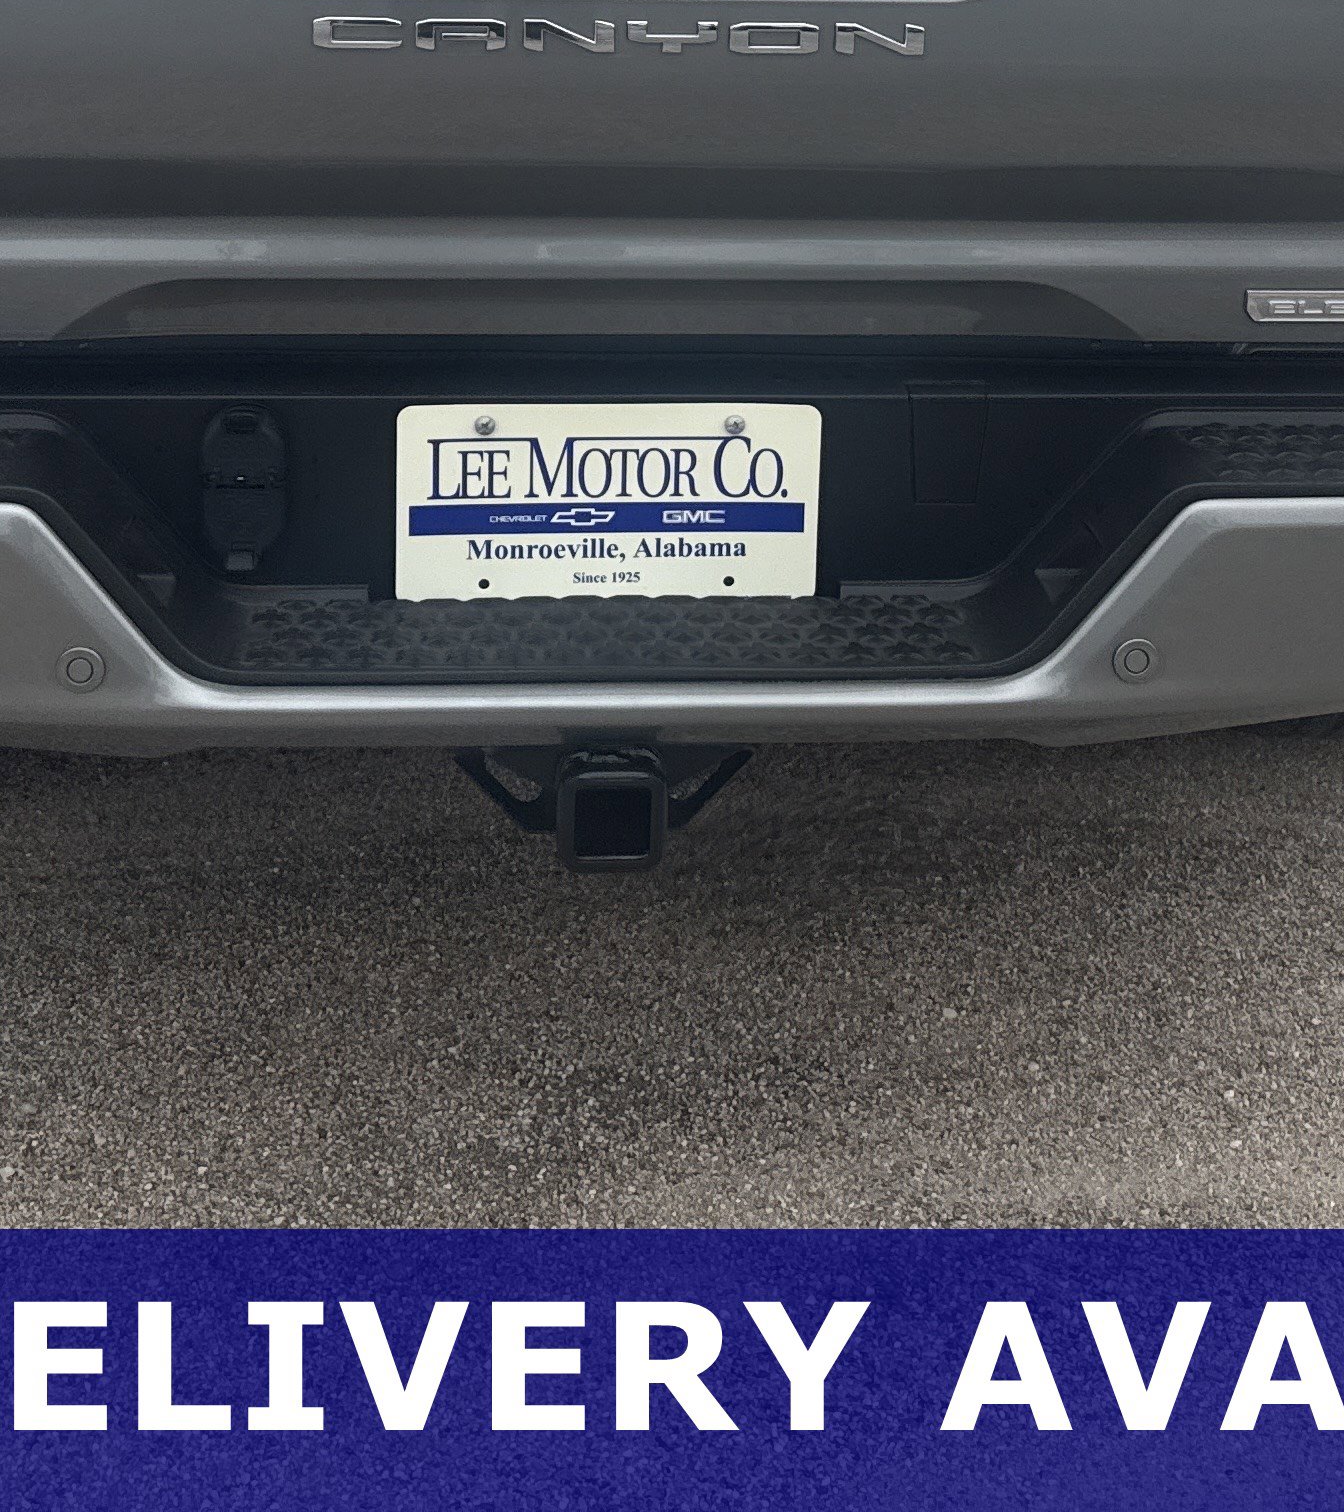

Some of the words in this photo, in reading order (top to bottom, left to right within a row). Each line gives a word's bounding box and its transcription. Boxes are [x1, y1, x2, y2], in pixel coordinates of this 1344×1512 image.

[312, 16, 926, 56] CANYON
[489, 514, 548, 524] CHEVROLET
[662, 509, 726, 524] GMC
[466, 537, 626, 563] Monroeville,
[633, 537, 747, 558] Alabama
[572, 571, 608, 585] Since
[611, 571, 641, 584] 1925
